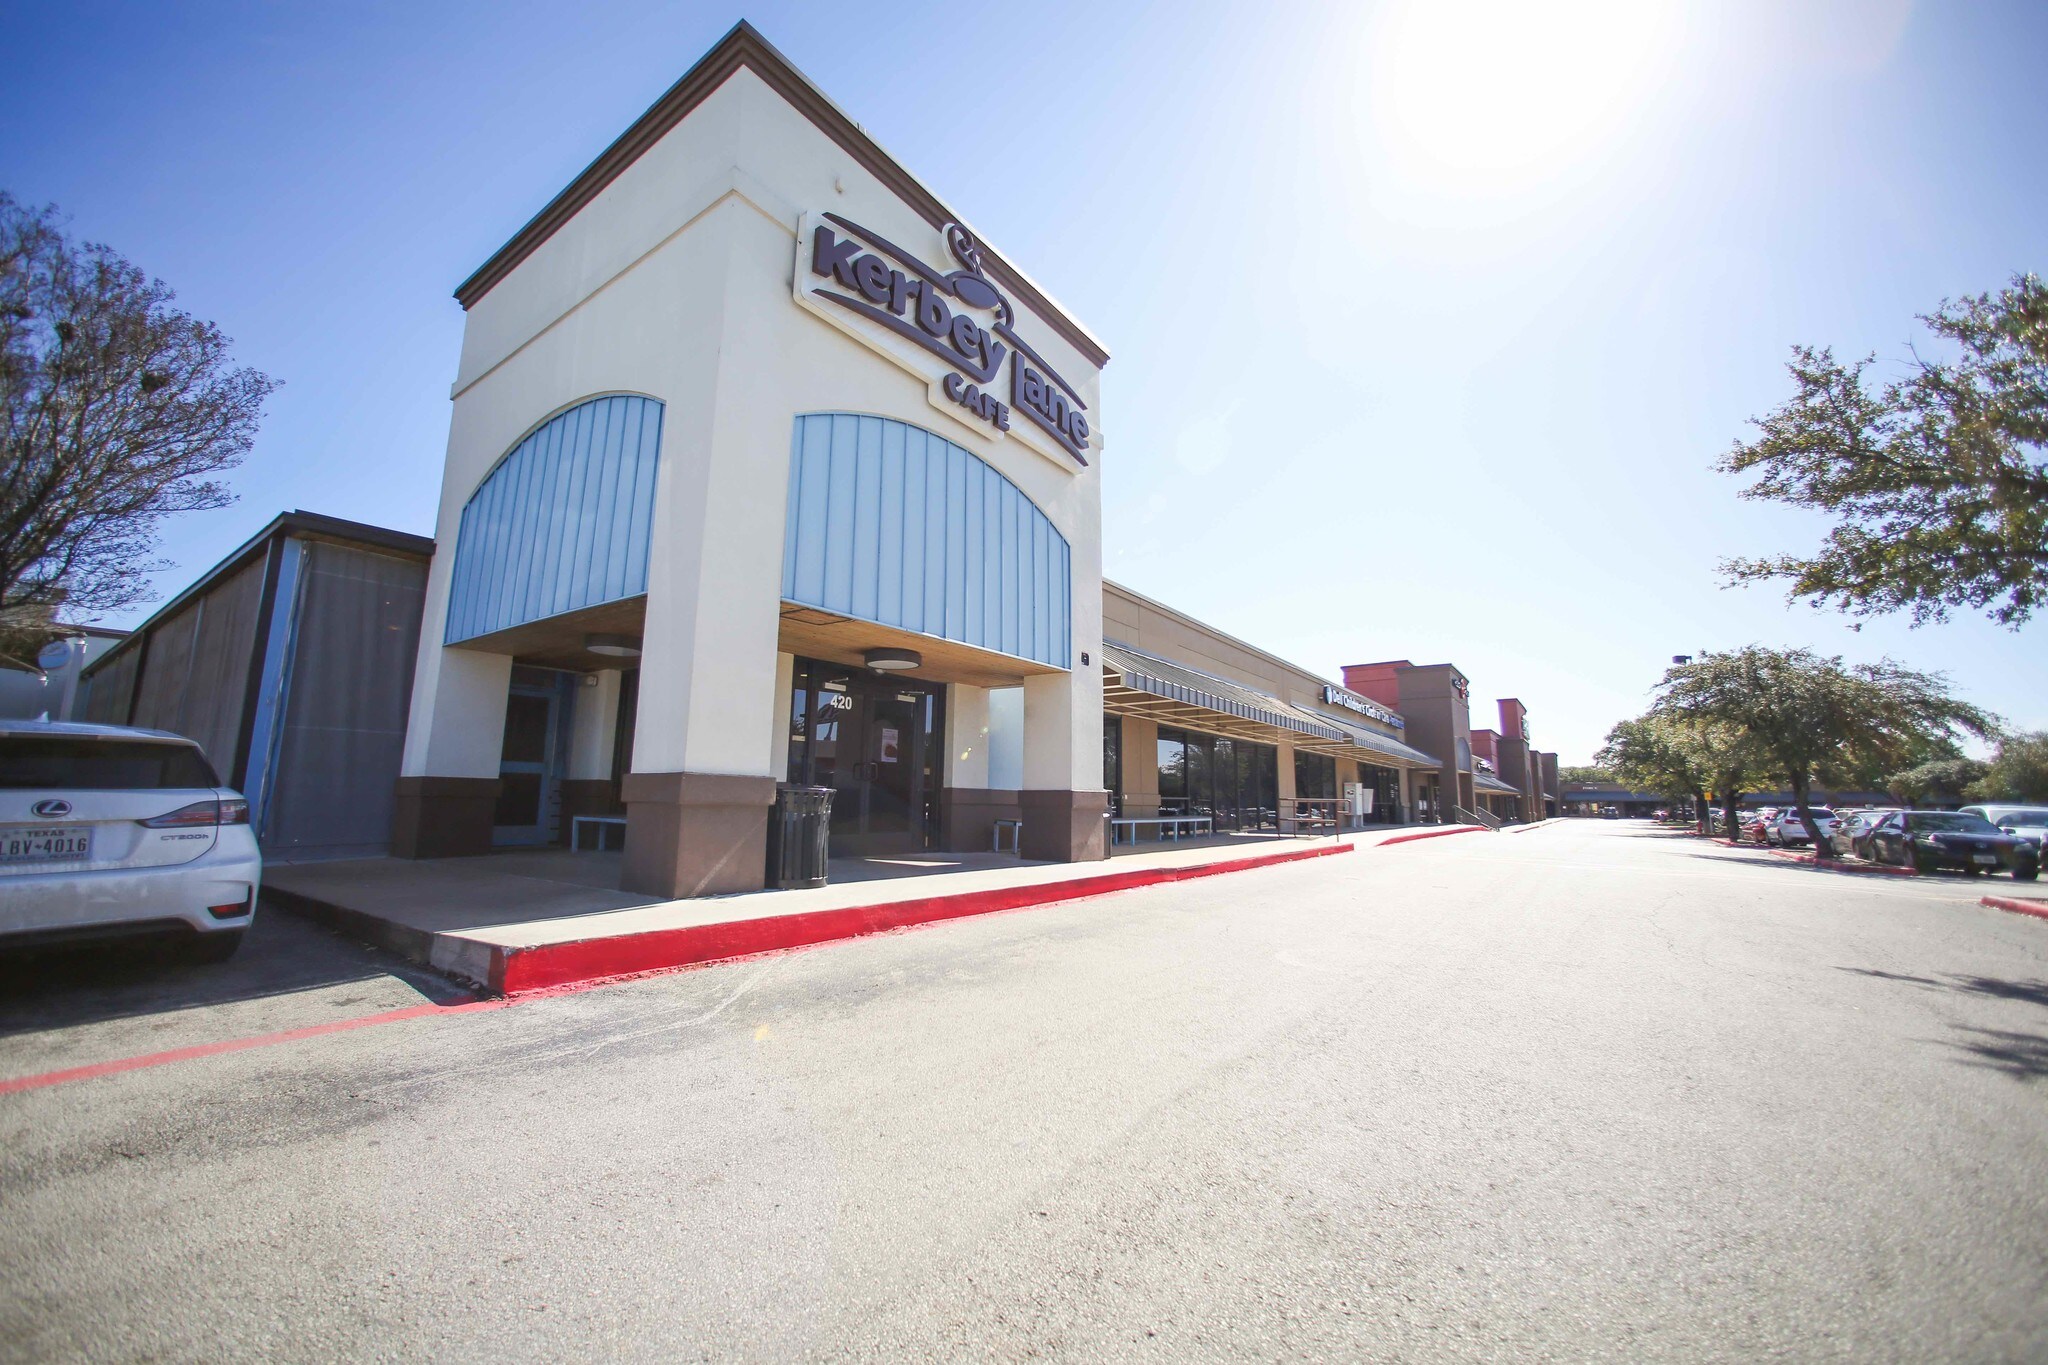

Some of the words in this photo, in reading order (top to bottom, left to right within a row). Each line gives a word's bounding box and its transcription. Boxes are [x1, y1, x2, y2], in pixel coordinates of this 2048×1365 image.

[943, 372, 1010, 432] CAFE
[830, 695, 852, 710] 420
[26, 829, 65, 837] TEXAS
